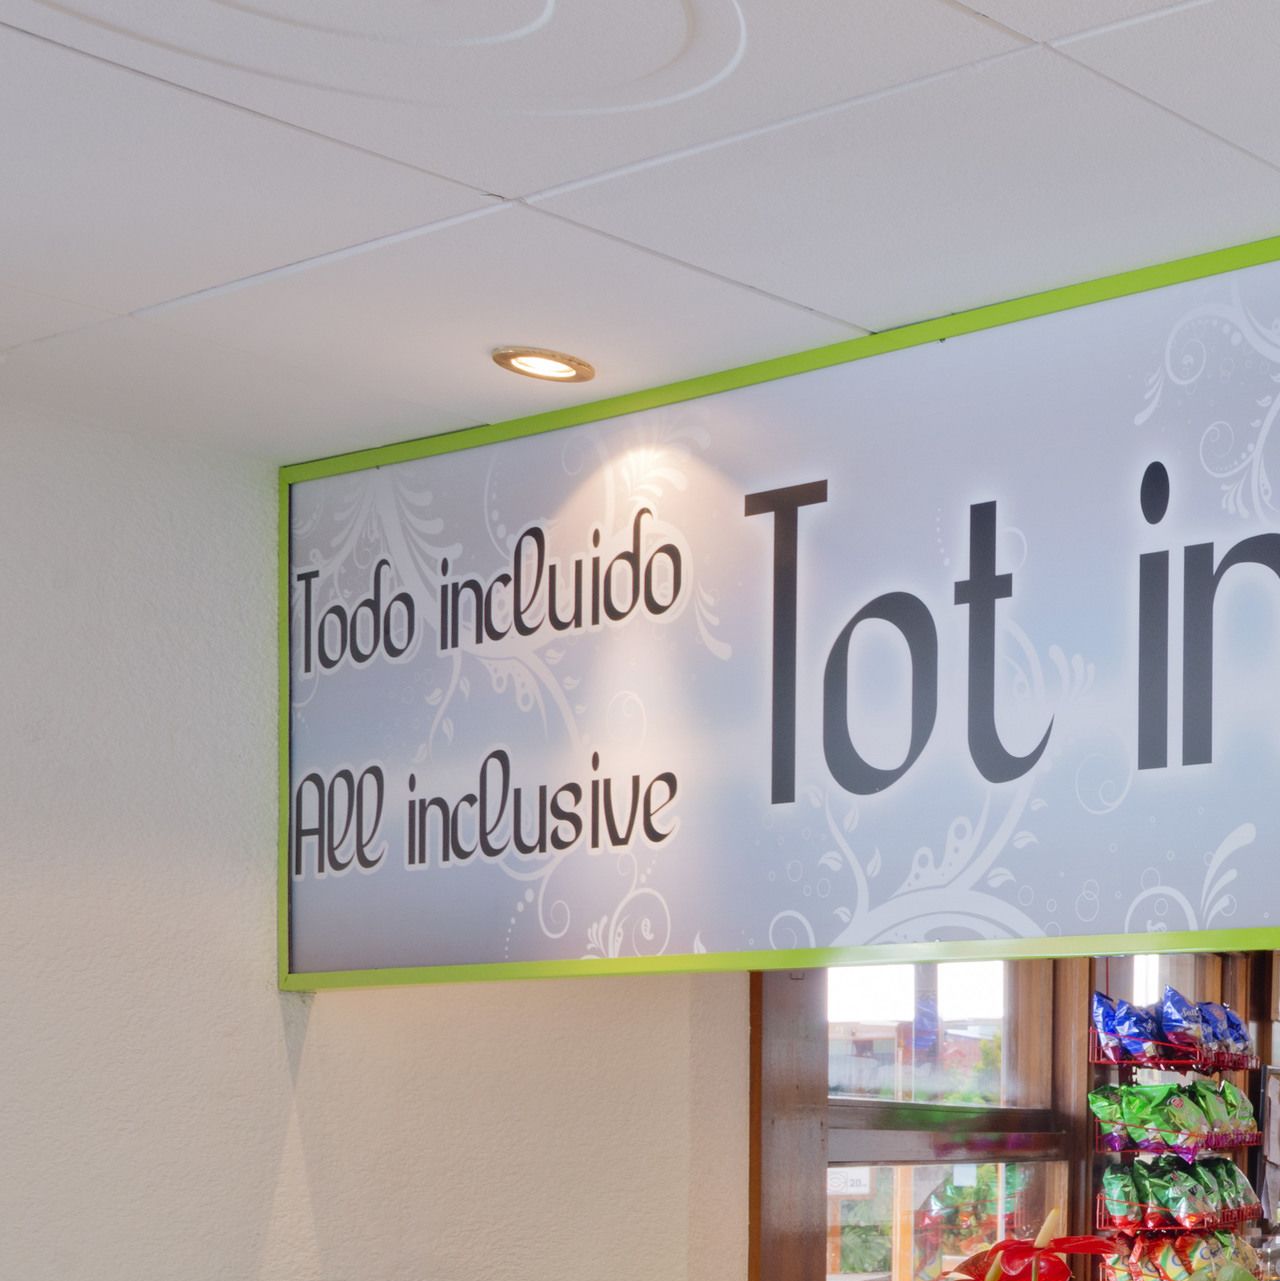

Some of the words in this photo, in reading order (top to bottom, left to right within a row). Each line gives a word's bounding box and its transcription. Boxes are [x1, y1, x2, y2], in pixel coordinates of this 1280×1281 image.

[296, 558, 415, 673] Todo
[439, 507, 683, 651] incluido
[744, 479, 1056, 805] Tot
[294, 764, 386, 876] All
[406, 750, 678, 866] inclusive
